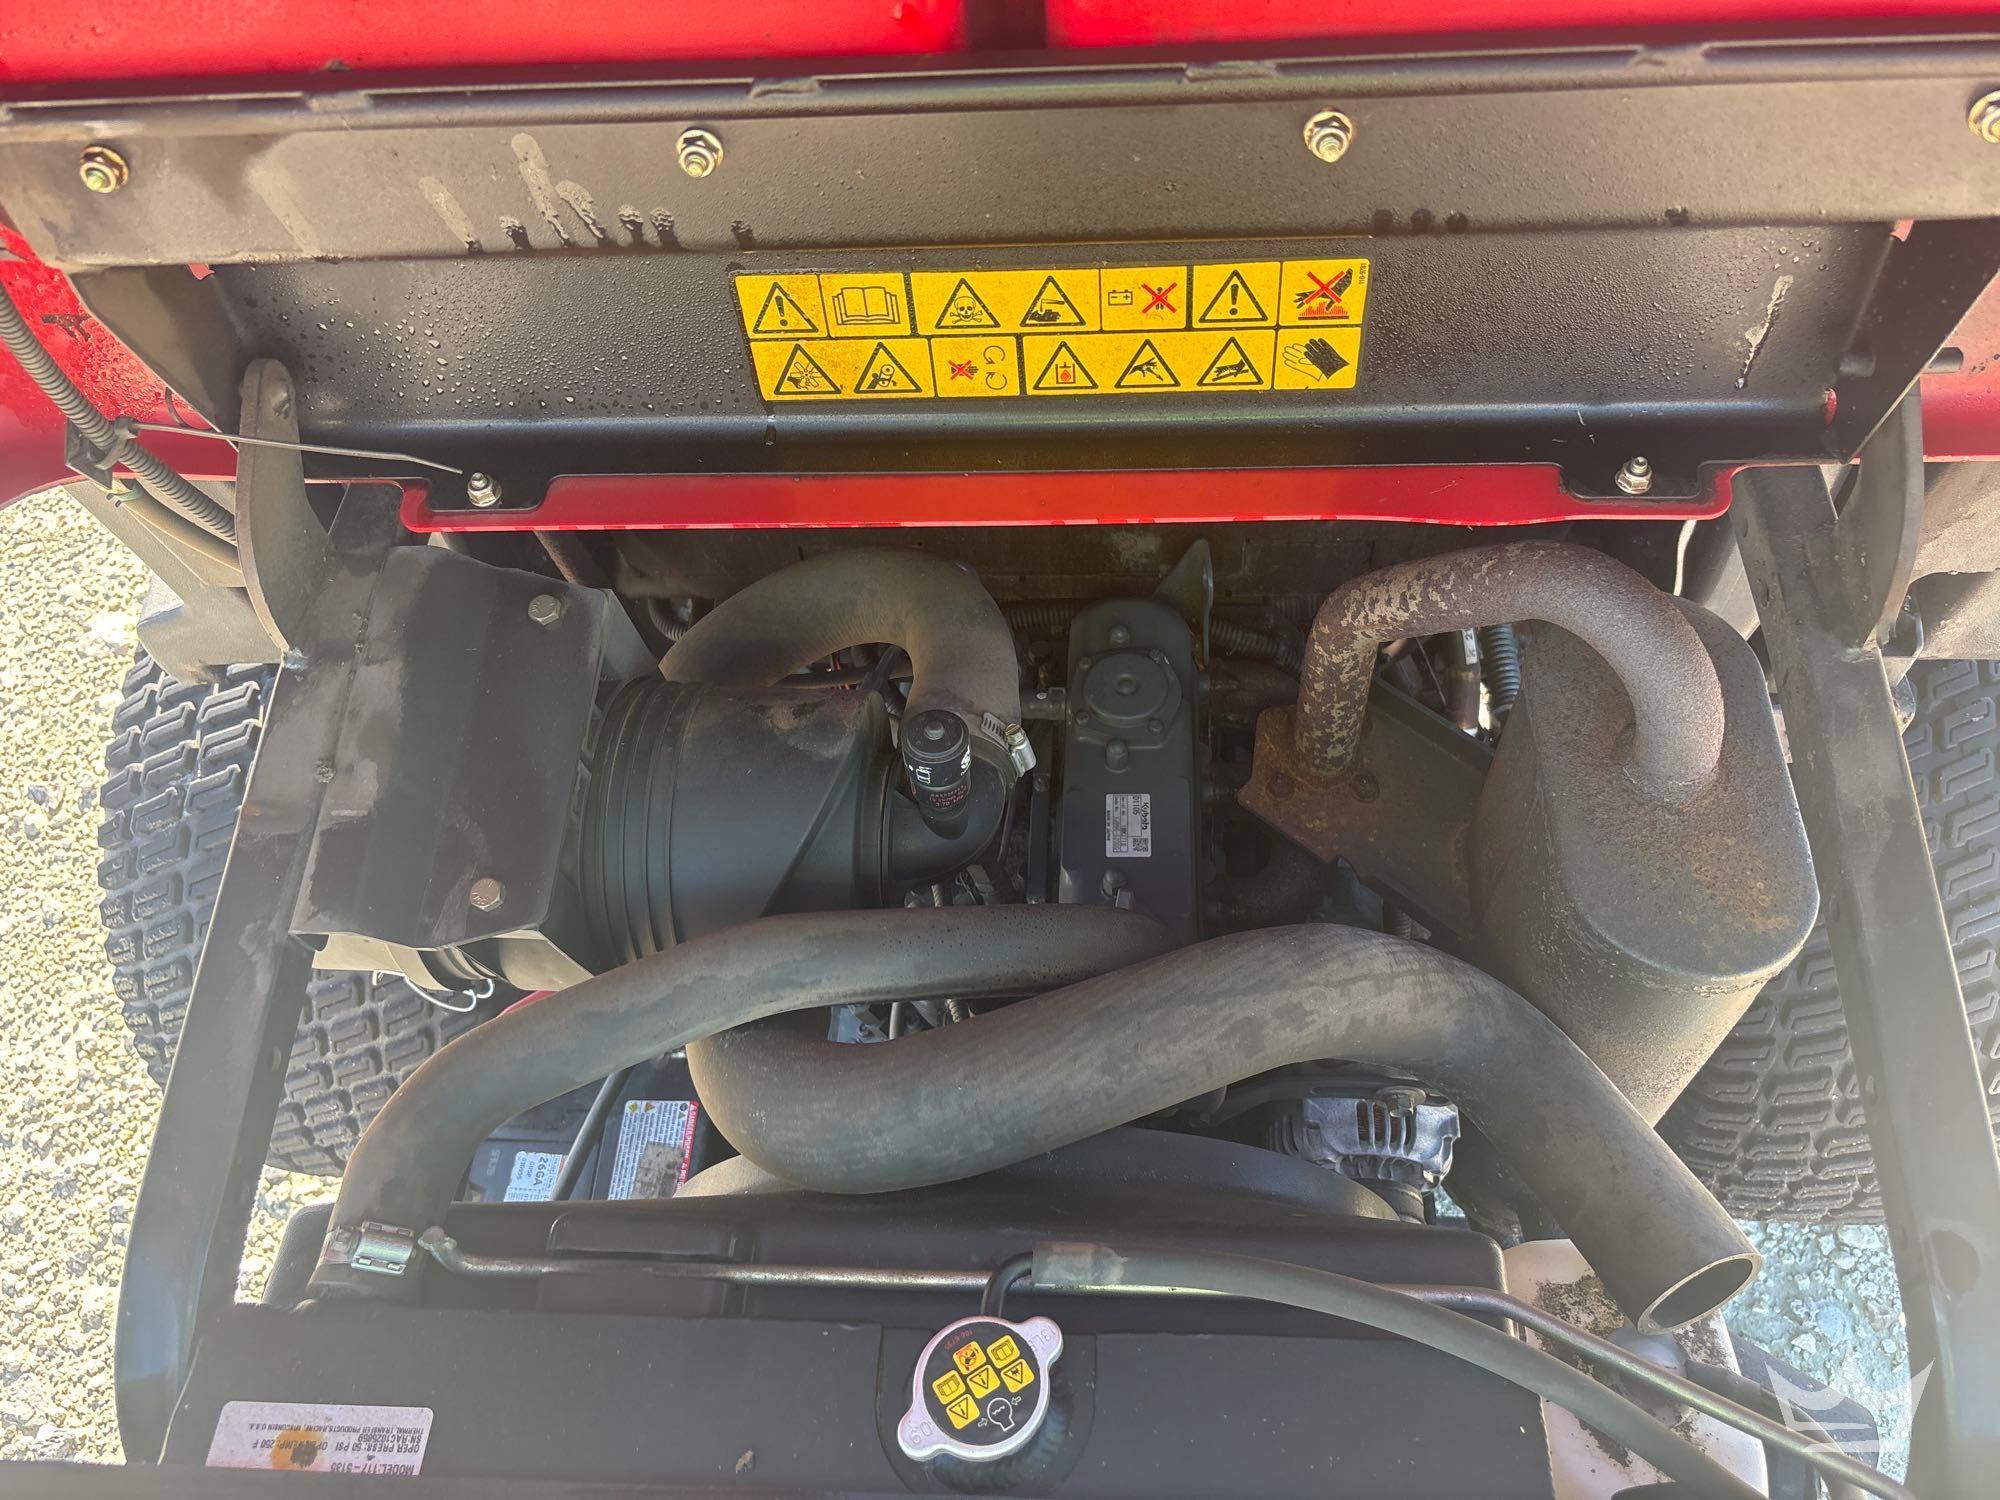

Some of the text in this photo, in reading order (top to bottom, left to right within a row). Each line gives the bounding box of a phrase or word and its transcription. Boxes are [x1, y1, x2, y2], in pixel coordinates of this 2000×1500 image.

[1142, 802, 1150, 830] Kubota
[533, 1156, 548, 1186] 26GA
[335, 1441, 350, 1451] PSI
[397, 1443, 420, 1453] OPER
